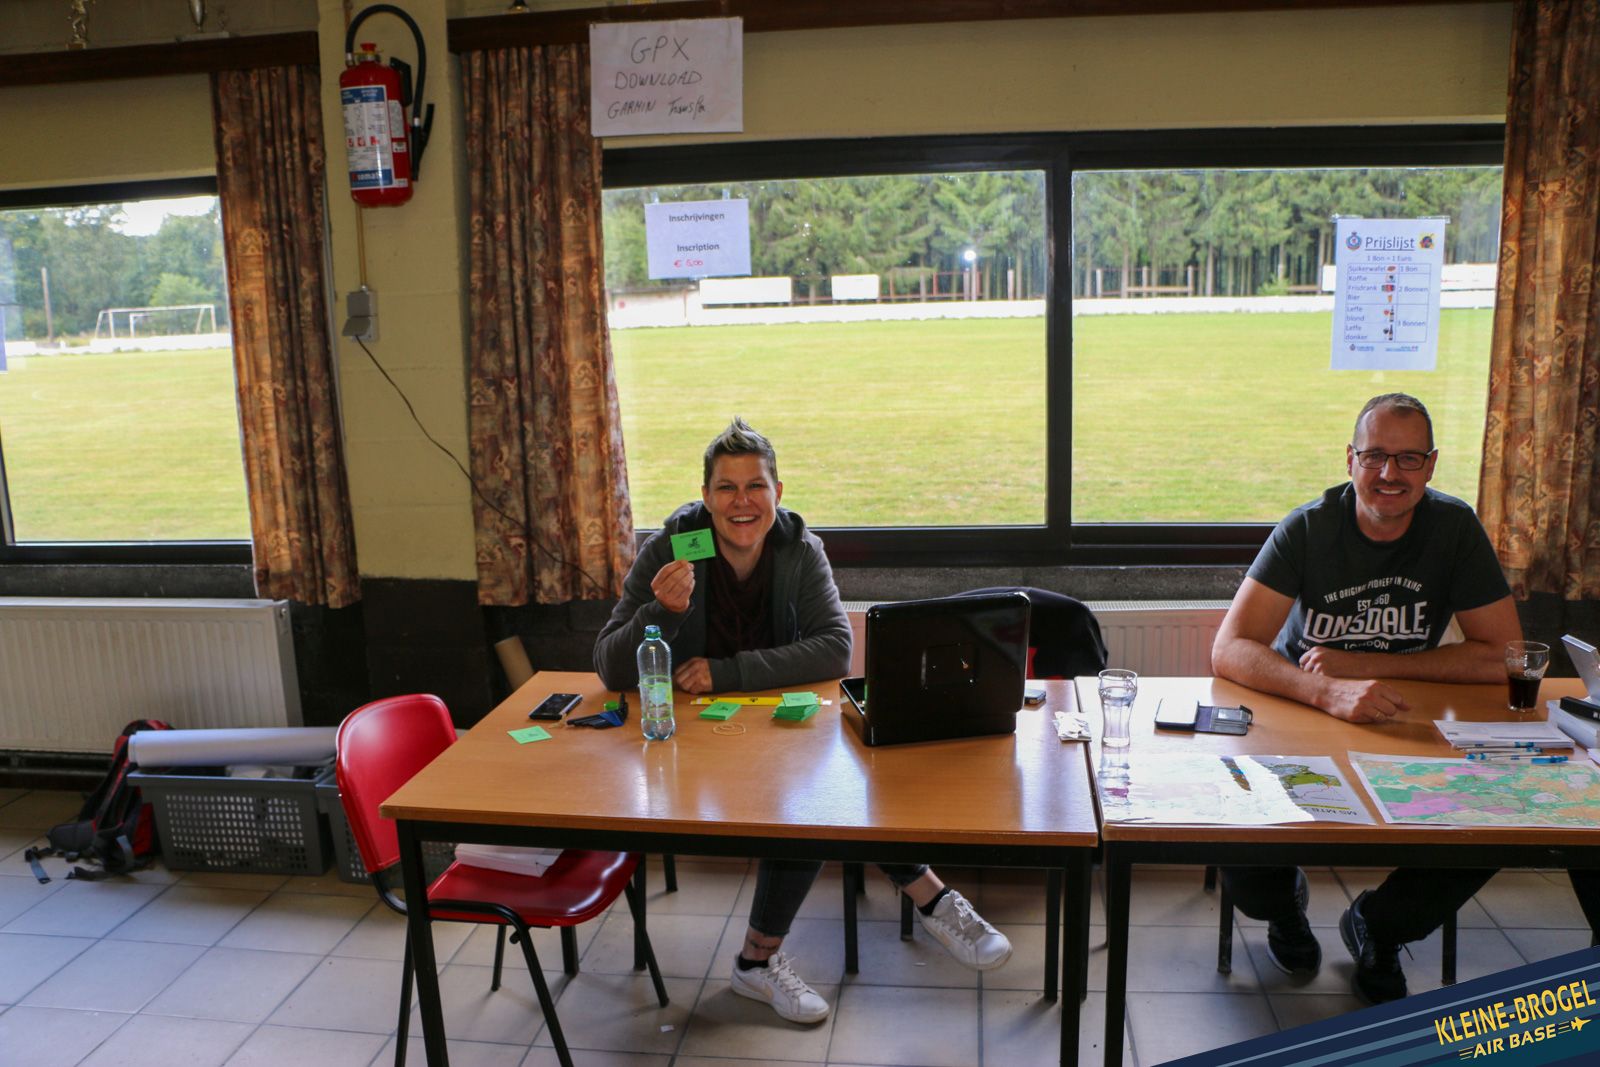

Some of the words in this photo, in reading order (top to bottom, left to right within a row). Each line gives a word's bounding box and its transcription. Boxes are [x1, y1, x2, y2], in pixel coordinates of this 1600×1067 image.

[631, 35, 690, 64] GPX
[614, 70, 702, 90] DOWNLOAD
[607, 99, 657, 119] GARMIN
[669, 213, 725, 222] Inschrijvingen
[677, 243, 720, 252] Inscription
[1365, 236, 1415, 251] Prijslijst
[1324, 591, 1338, 604] THE
[1357, 599, 1372, 612] EST
[1303, 601, 1428, 639] LONSDALE
